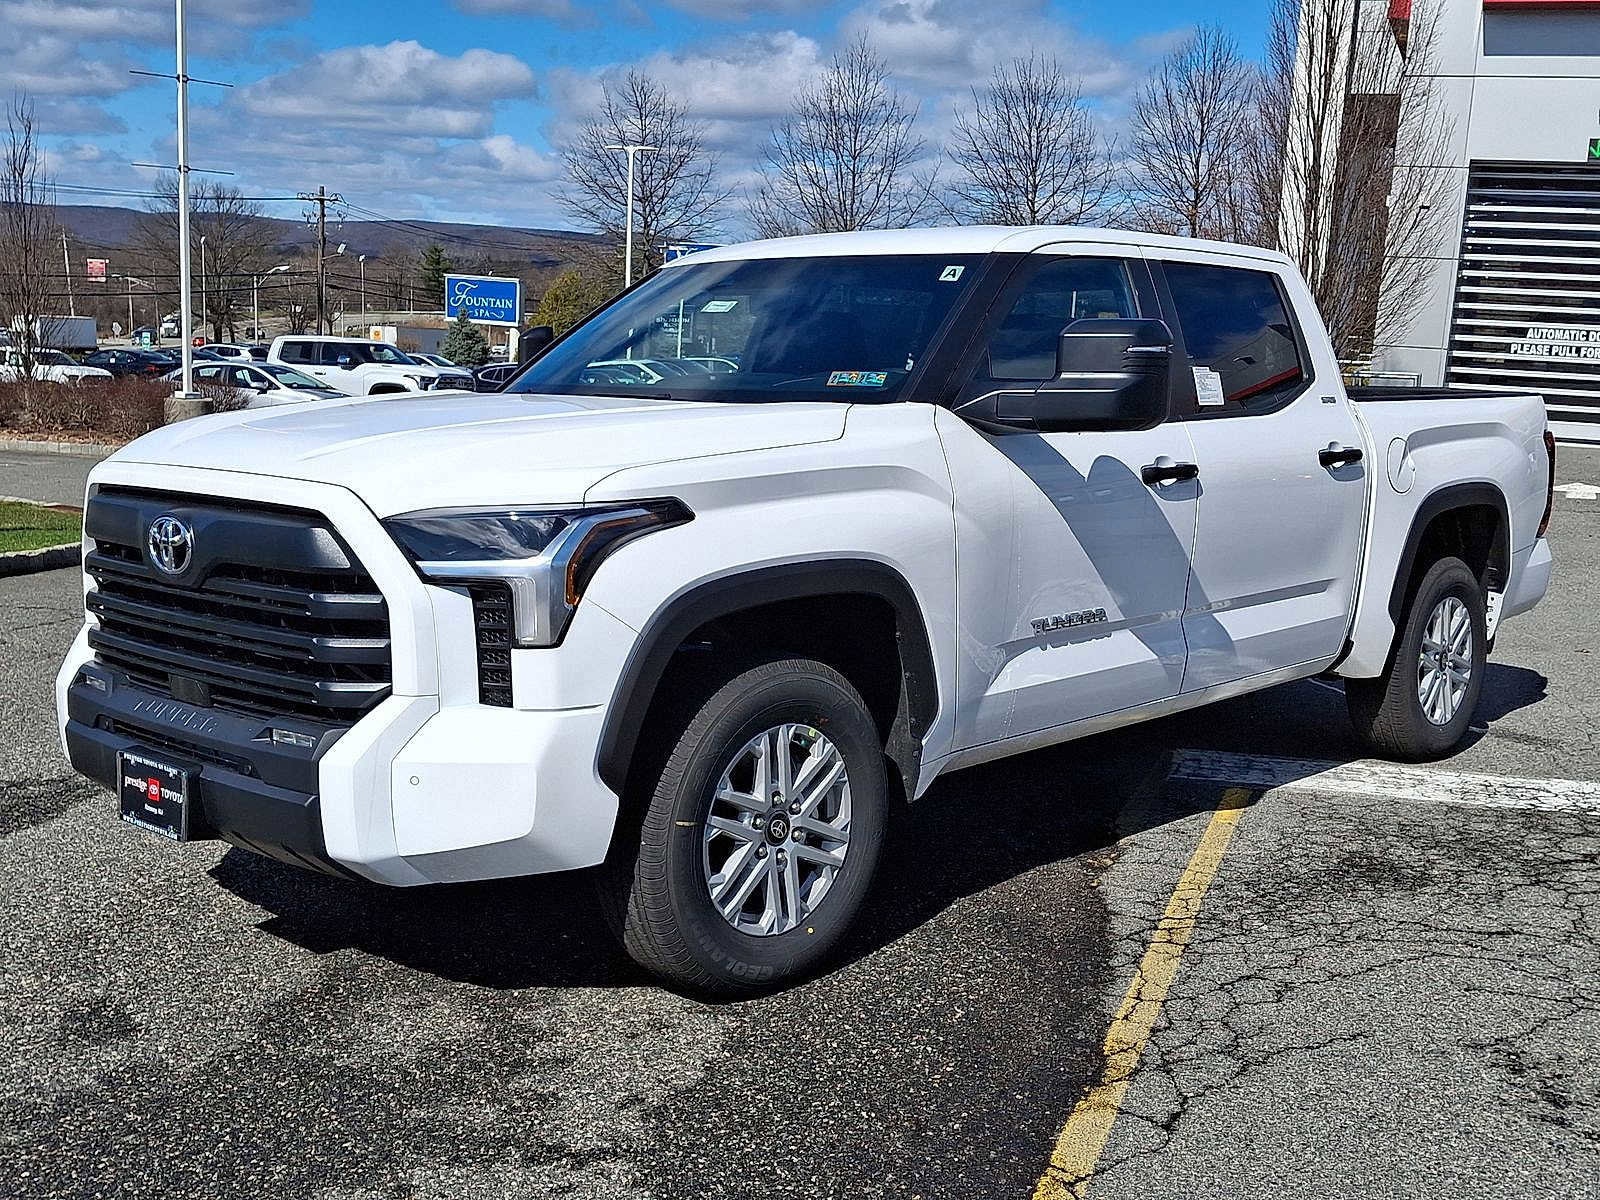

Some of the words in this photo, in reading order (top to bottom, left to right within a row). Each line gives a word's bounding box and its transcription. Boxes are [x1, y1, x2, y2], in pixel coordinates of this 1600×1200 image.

[943, 268, 957, 279] A
[450, 281, 513, 309] FOUNTAIN
[474, 309, 490, 318] SPA
[1526, 327, 1587, 341] AUTOMATIC
[1510, 343, 1551, 356] PLEASE
[1551, 345, 1579, 358] PULL
[1030, 607, 1108, 634] TUNDRA
[124, 775, 148, 793] prestige
